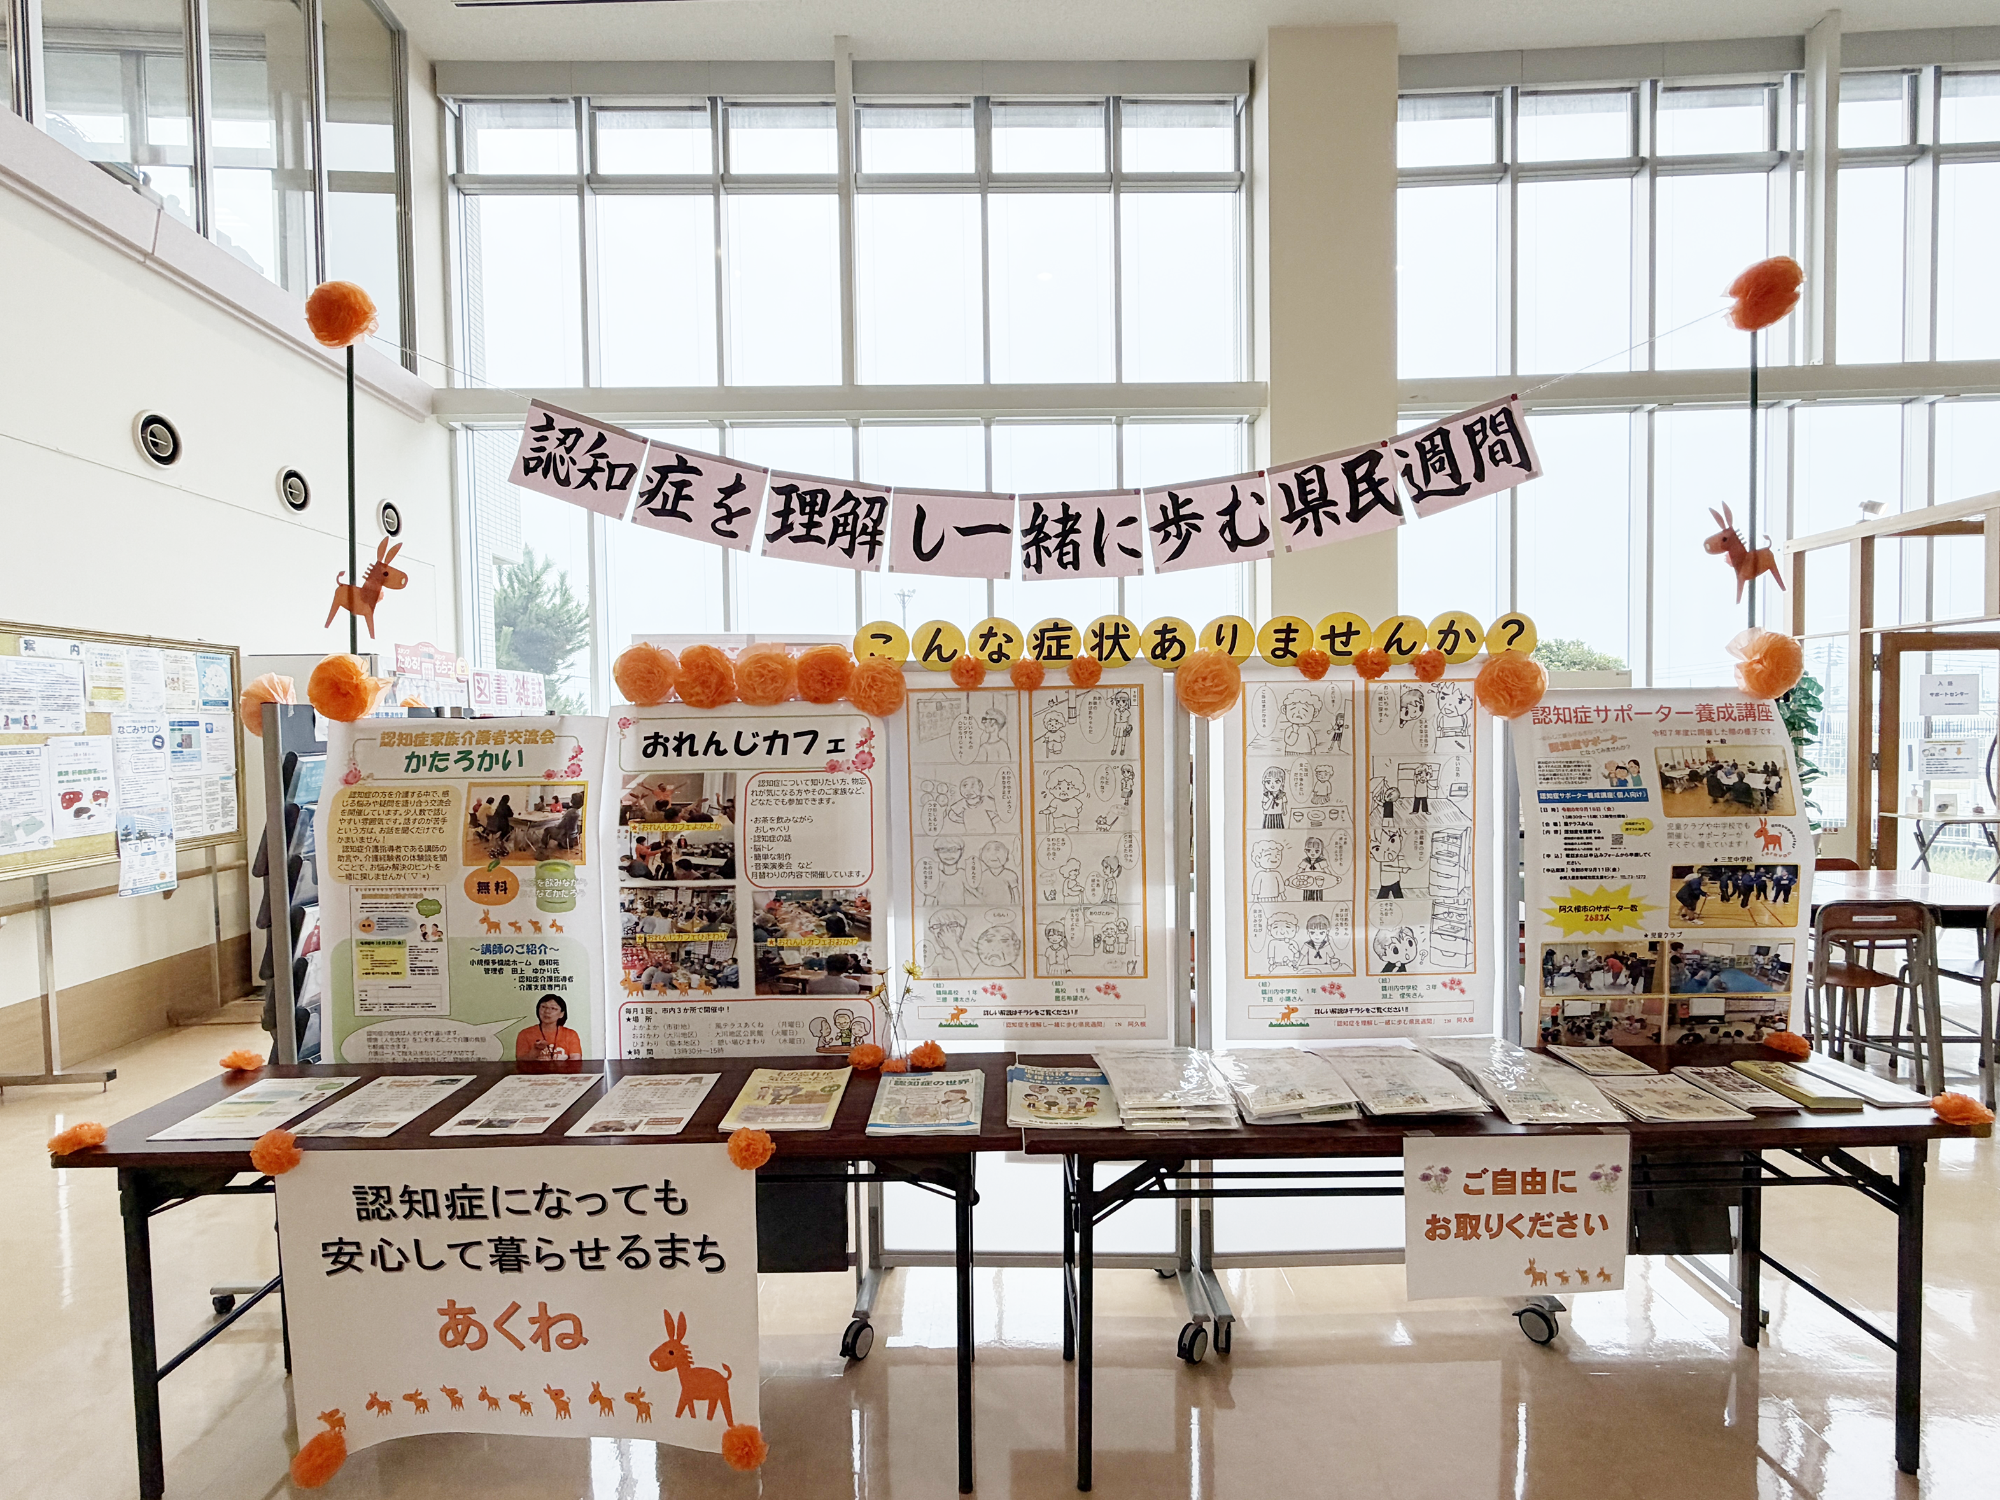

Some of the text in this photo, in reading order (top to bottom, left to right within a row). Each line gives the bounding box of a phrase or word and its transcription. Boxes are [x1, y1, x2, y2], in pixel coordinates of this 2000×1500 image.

[522, 406, 1532, 564] 認知症を理解し一緒に歩む県民週間
[1531, 702, 1774, 726] 認知症サポーター養成講座
[379, 729, 556, 748] 認知症家族介護者交流会
[642, 729, 846, 758] おれんじカフェ
[404, 749, 524, 773] かたろかい
[477, 880, 508, 895] 無料
[1462, 1167, 1578, 1196] ご自由に
[352, 1179, 689, 1223] 認知症になっても
[1424, 1211, 1609, 1242] お取りください
[321, 1233, 727, 1277] 安心して暮らせるまち
[437, 1299, 589, 1353] あくね
